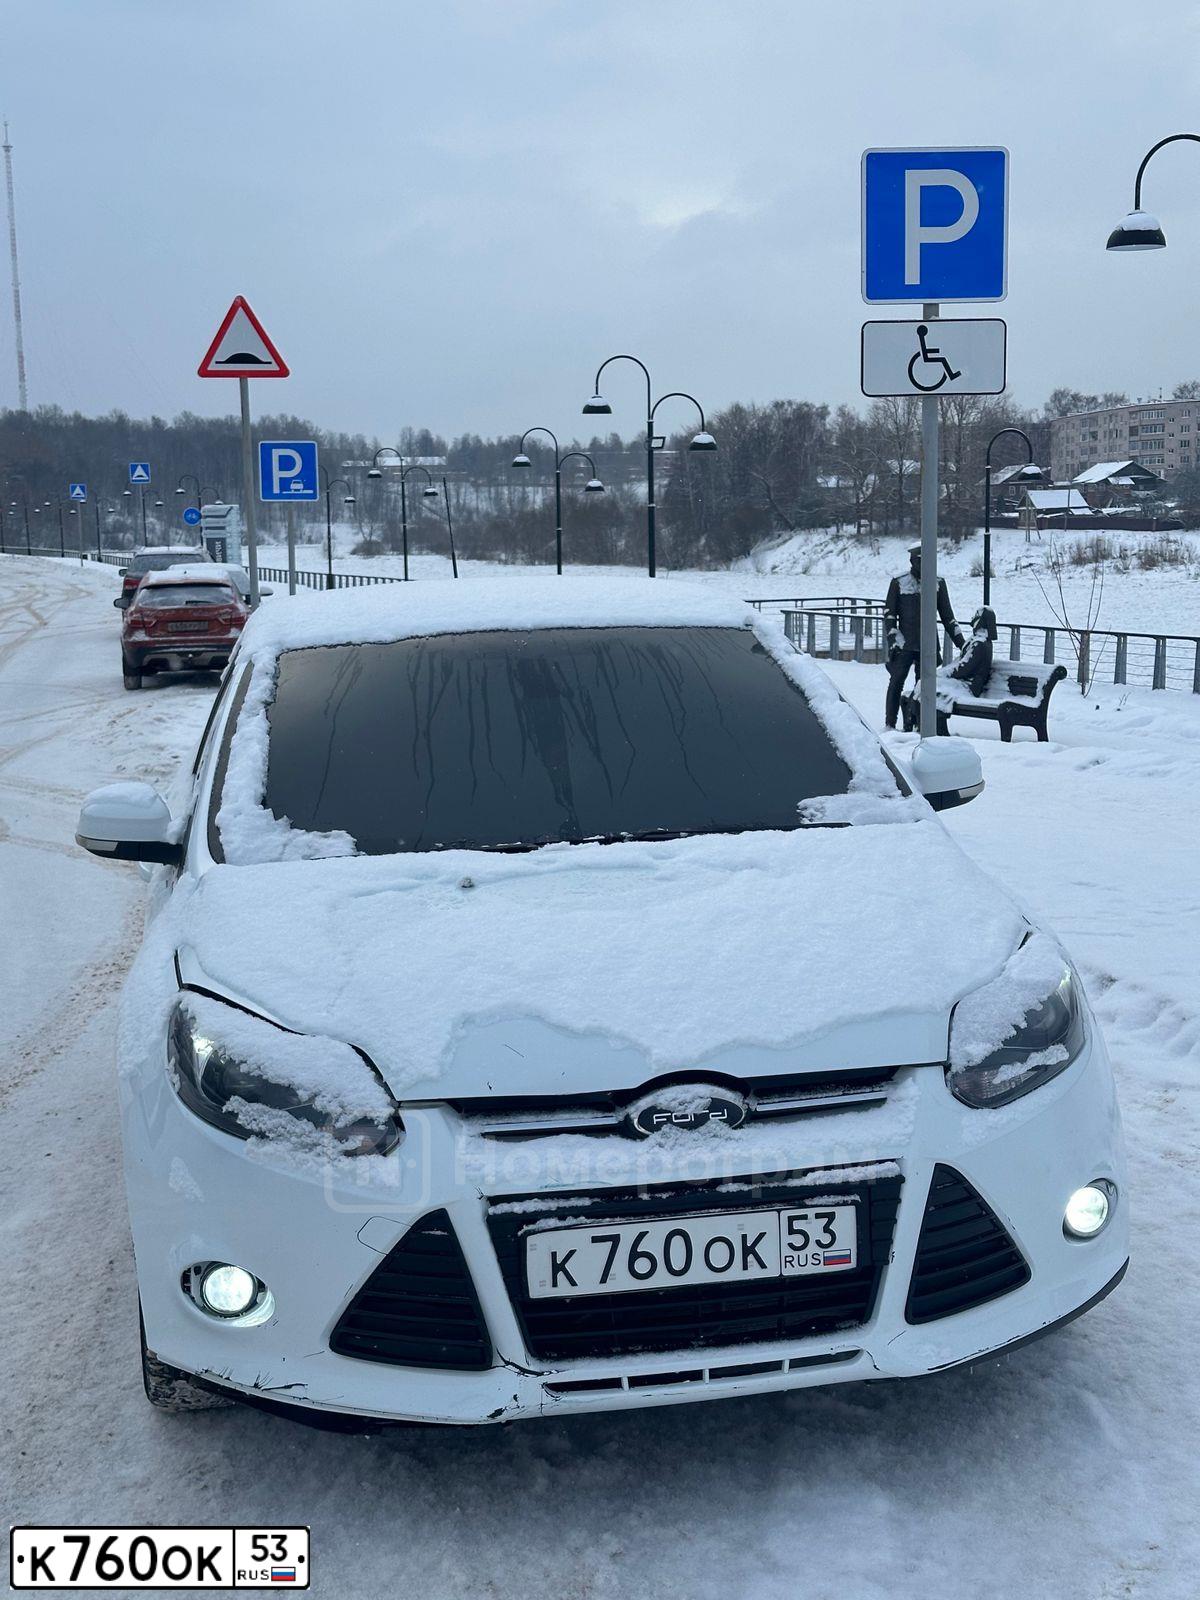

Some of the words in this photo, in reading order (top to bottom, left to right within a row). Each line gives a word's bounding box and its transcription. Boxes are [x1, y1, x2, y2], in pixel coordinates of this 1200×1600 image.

[905, 168, 980, 285] P
[272, 448, 303, 494] P
[787, 1211, 837, 1252] 53
[784, 1252, 822, 1269] RUS
